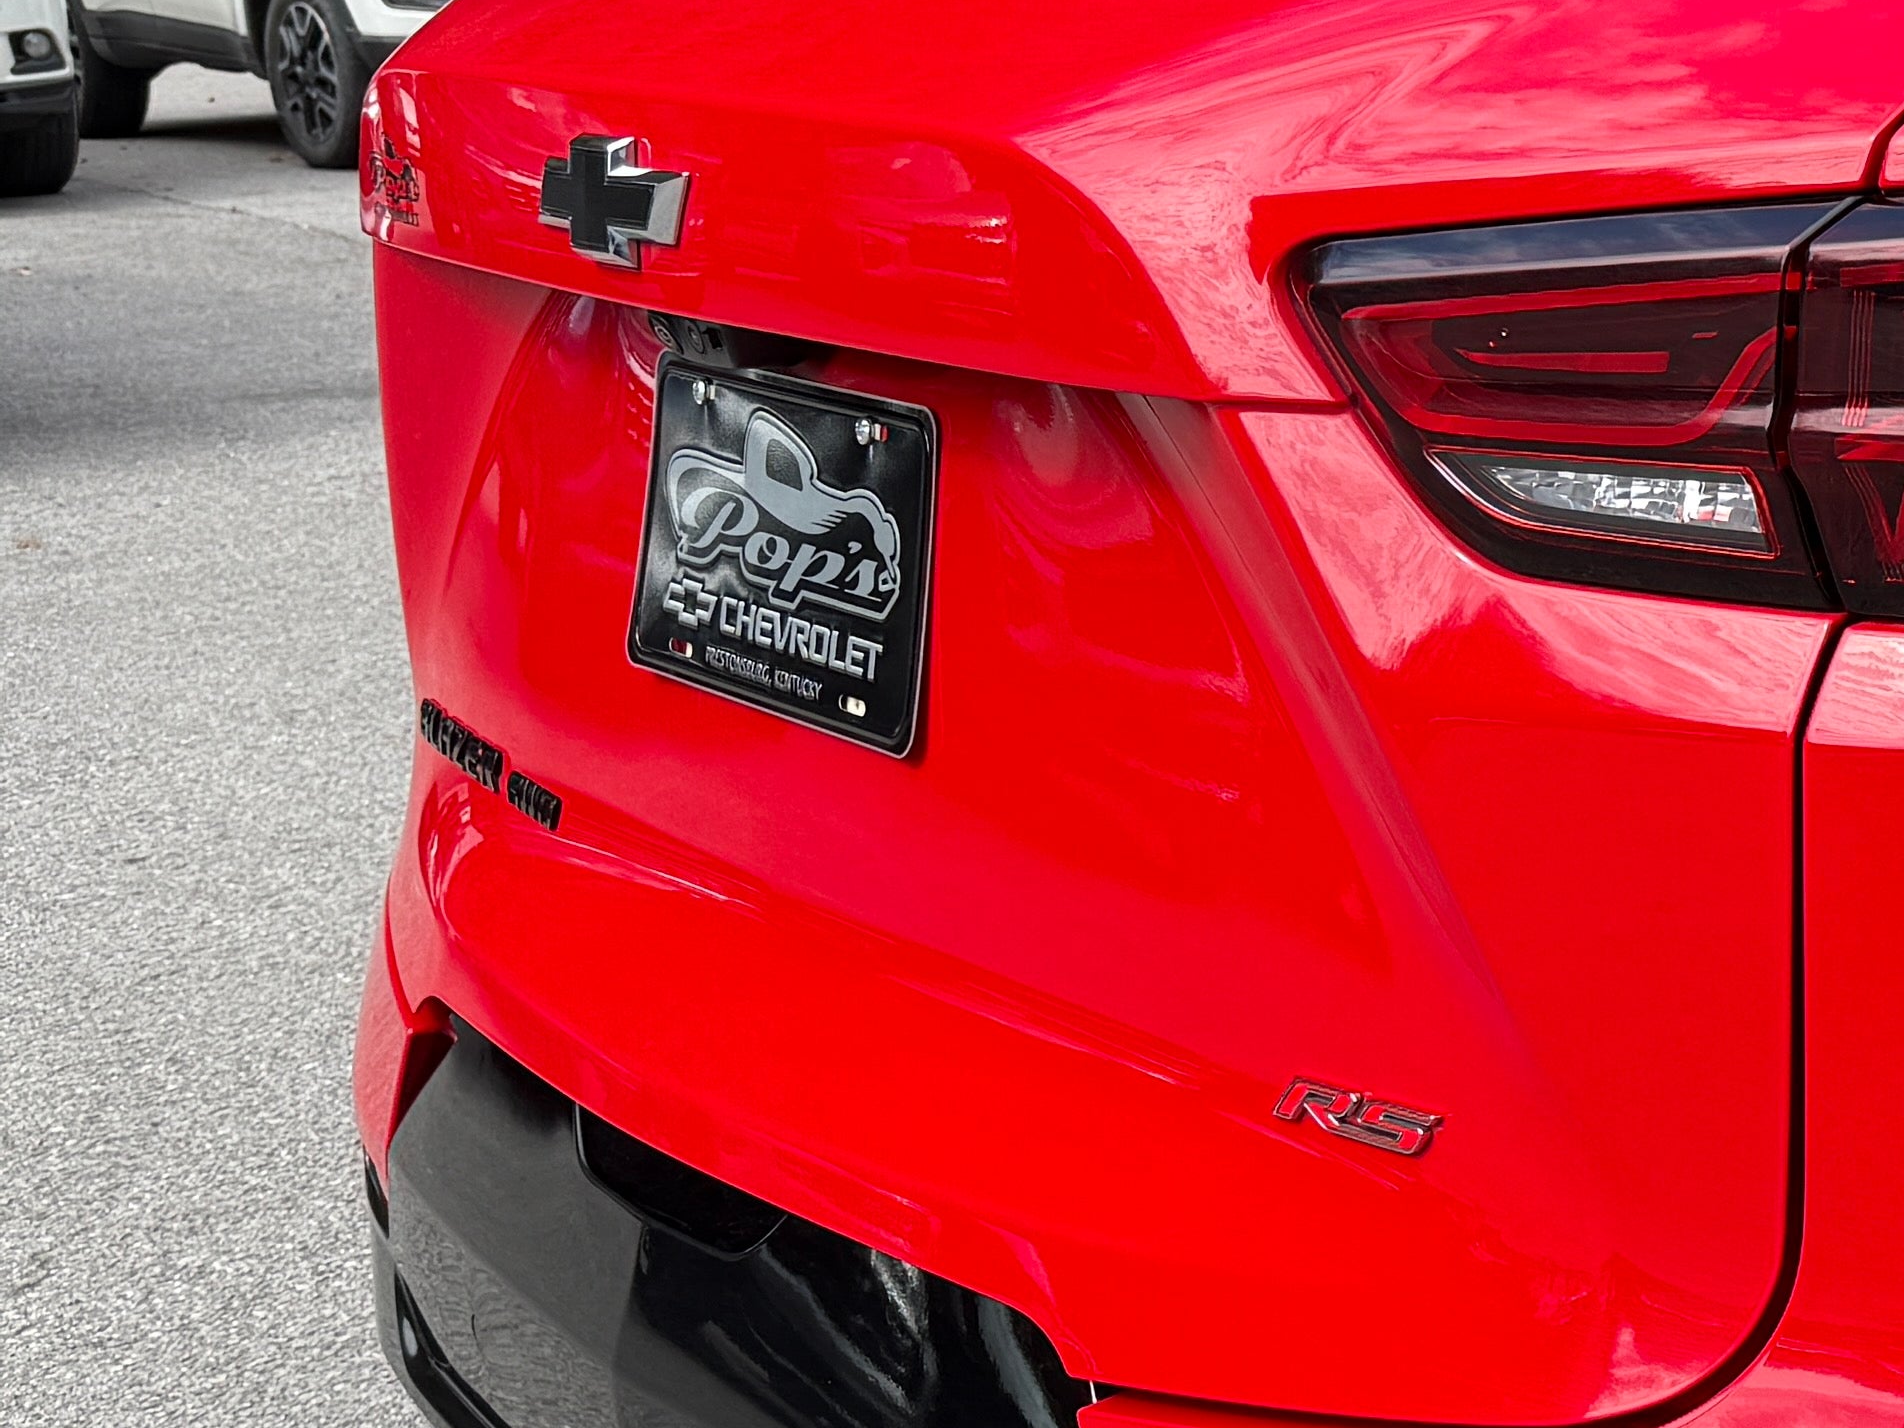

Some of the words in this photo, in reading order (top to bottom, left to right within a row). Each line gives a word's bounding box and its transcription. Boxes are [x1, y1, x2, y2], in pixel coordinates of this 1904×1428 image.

[680, 486, 883, 603] Pop's
[719, 595, 884, 683] CHEVROLET
[774, 668, 823, 701] KENTUCKY
[1272, 1076, 1445, 1160] RS
